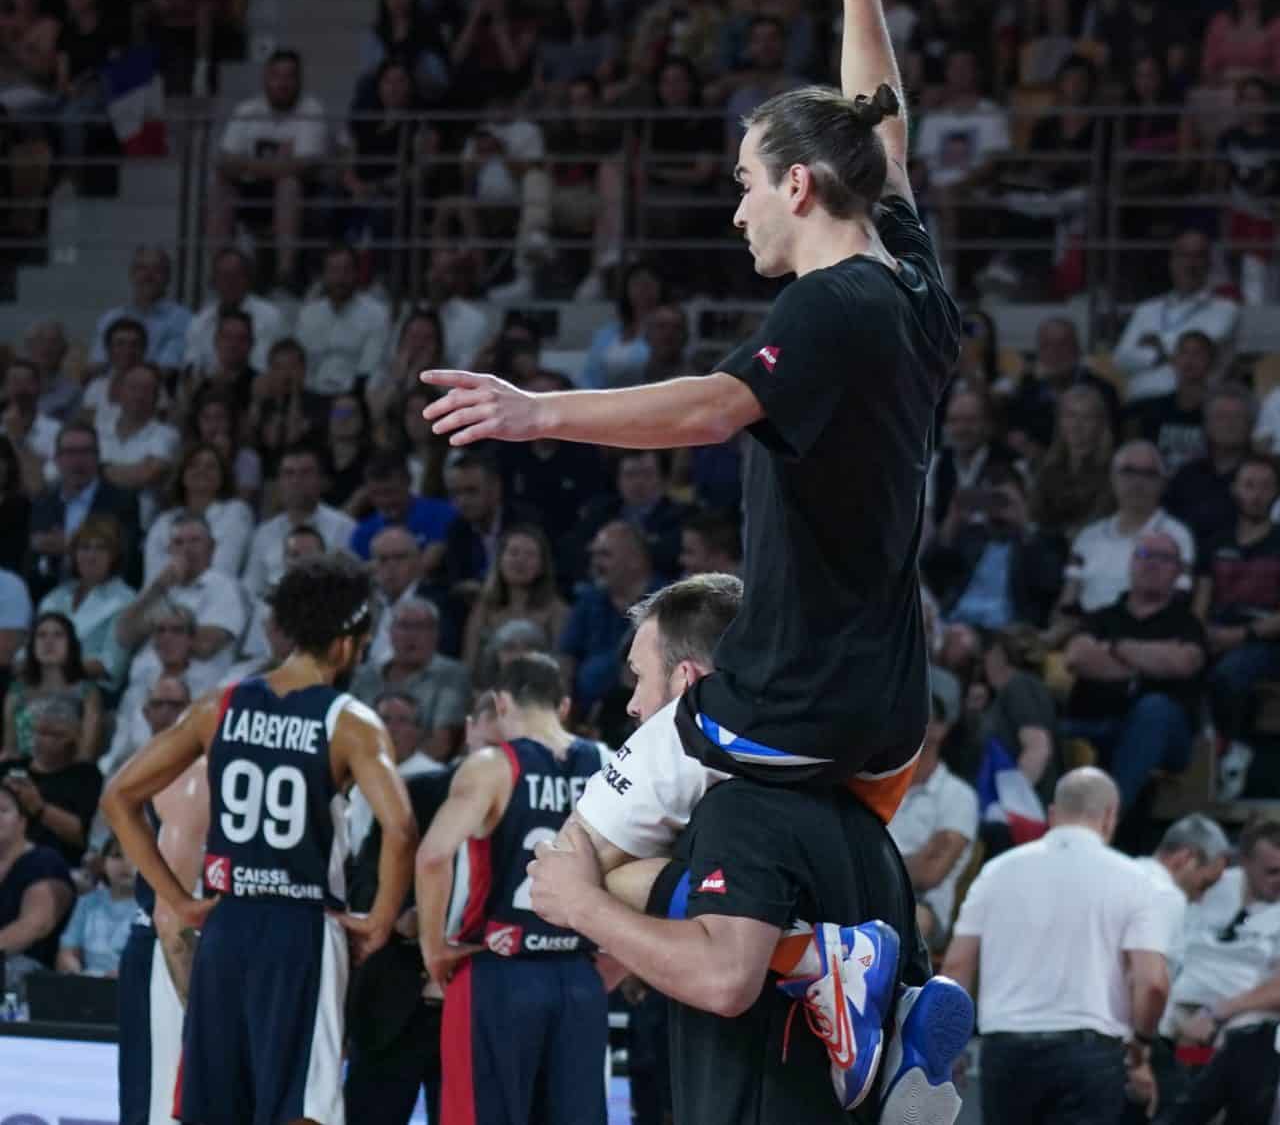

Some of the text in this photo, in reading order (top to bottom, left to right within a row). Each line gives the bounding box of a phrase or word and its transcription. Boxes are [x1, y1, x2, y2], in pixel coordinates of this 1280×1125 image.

[221, 707, 323, 754] LABEYRIE
[220, 758, 307, 850] 99
[525, 773, 587, 812] TAPE
